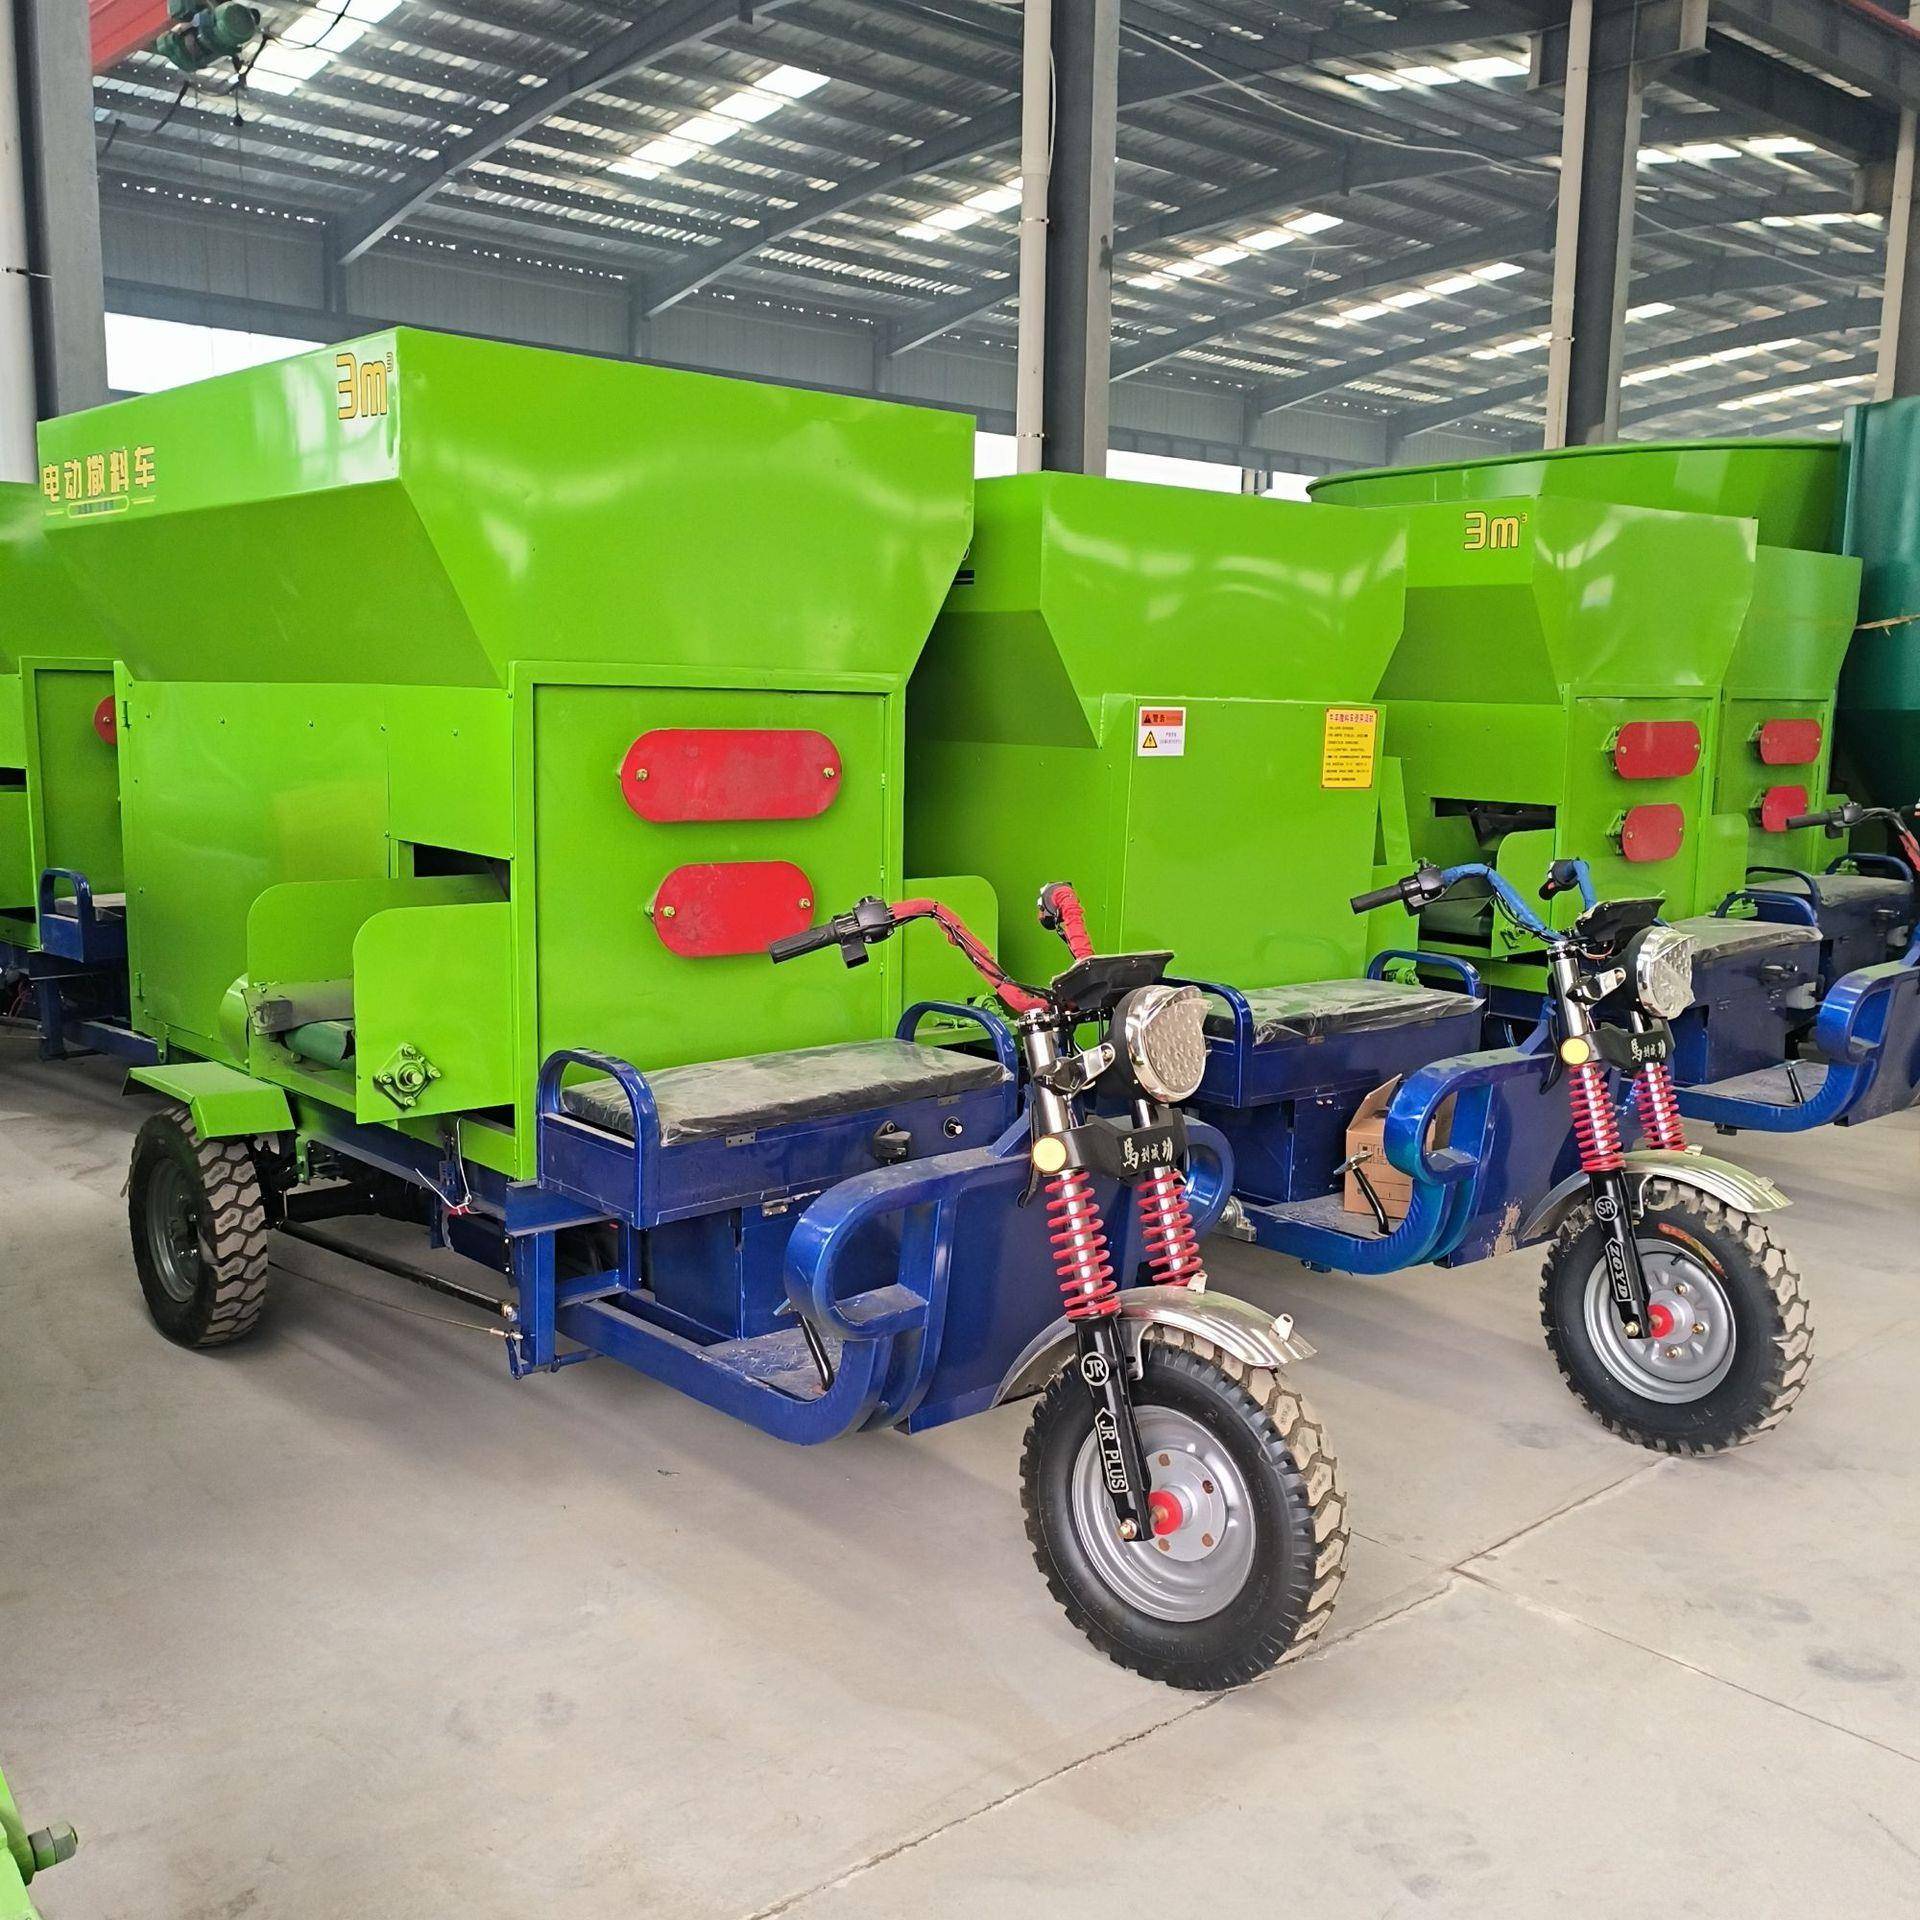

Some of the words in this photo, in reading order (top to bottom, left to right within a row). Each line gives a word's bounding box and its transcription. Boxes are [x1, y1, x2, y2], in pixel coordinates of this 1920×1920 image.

[42, 446, 156, 503] 电动撒料车
[1597, 1200, 1615, 1215] SR
[1086, 1359, 1106, 1379] JR
[1099, 1420, 1116, 1441] JR
[1104, 1449, 1126, 1492] PLUS
